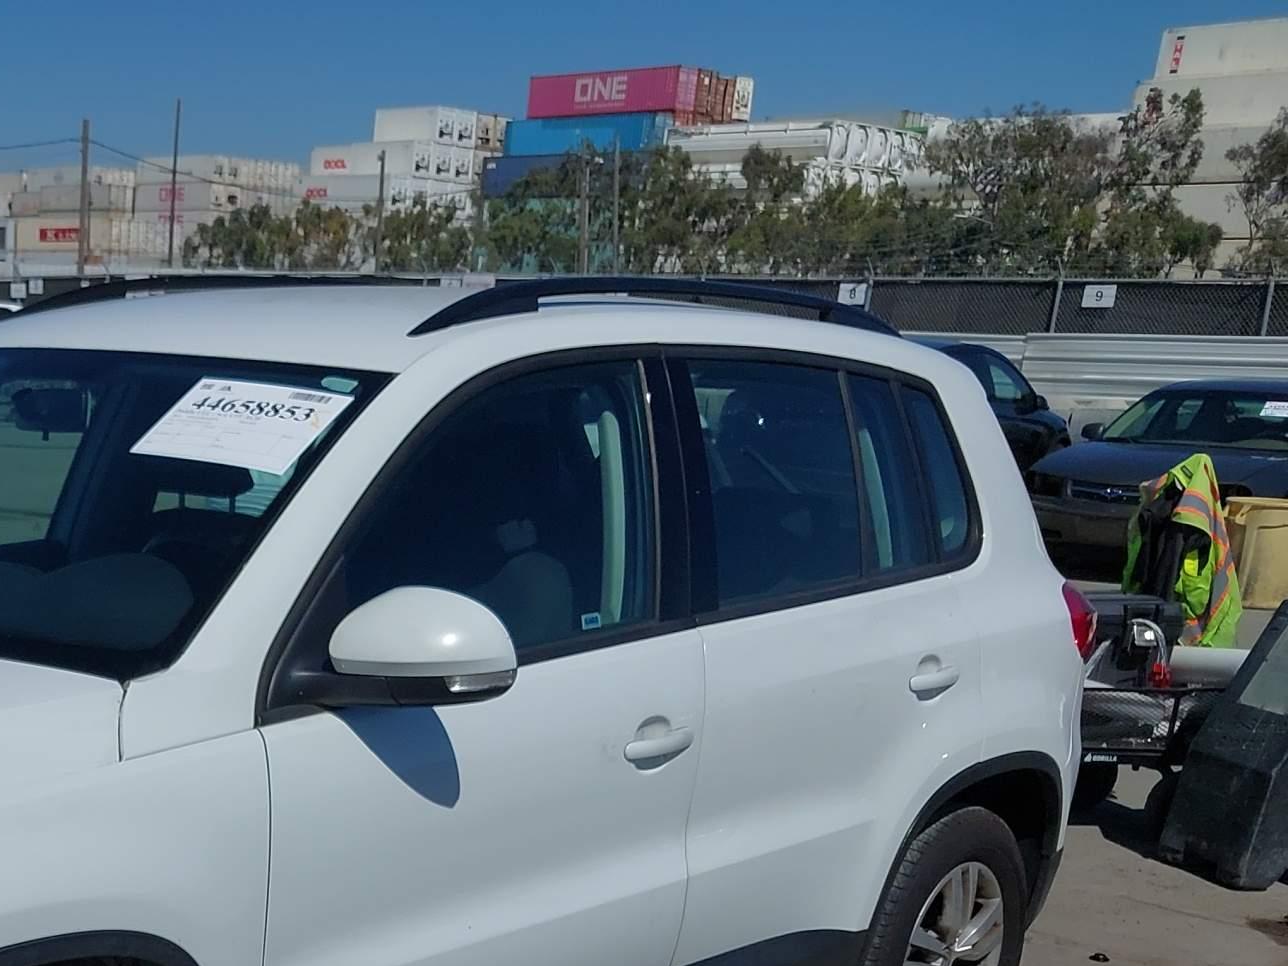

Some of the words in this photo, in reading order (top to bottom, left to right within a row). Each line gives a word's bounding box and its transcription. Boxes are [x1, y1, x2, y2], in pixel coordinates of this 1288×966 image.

[574, 76, 628, 102] ONE
[849, 288, 857, 300] 8
[1095, 290, 1104, 302] 9
[192, 396, 316, 422] 44658853
